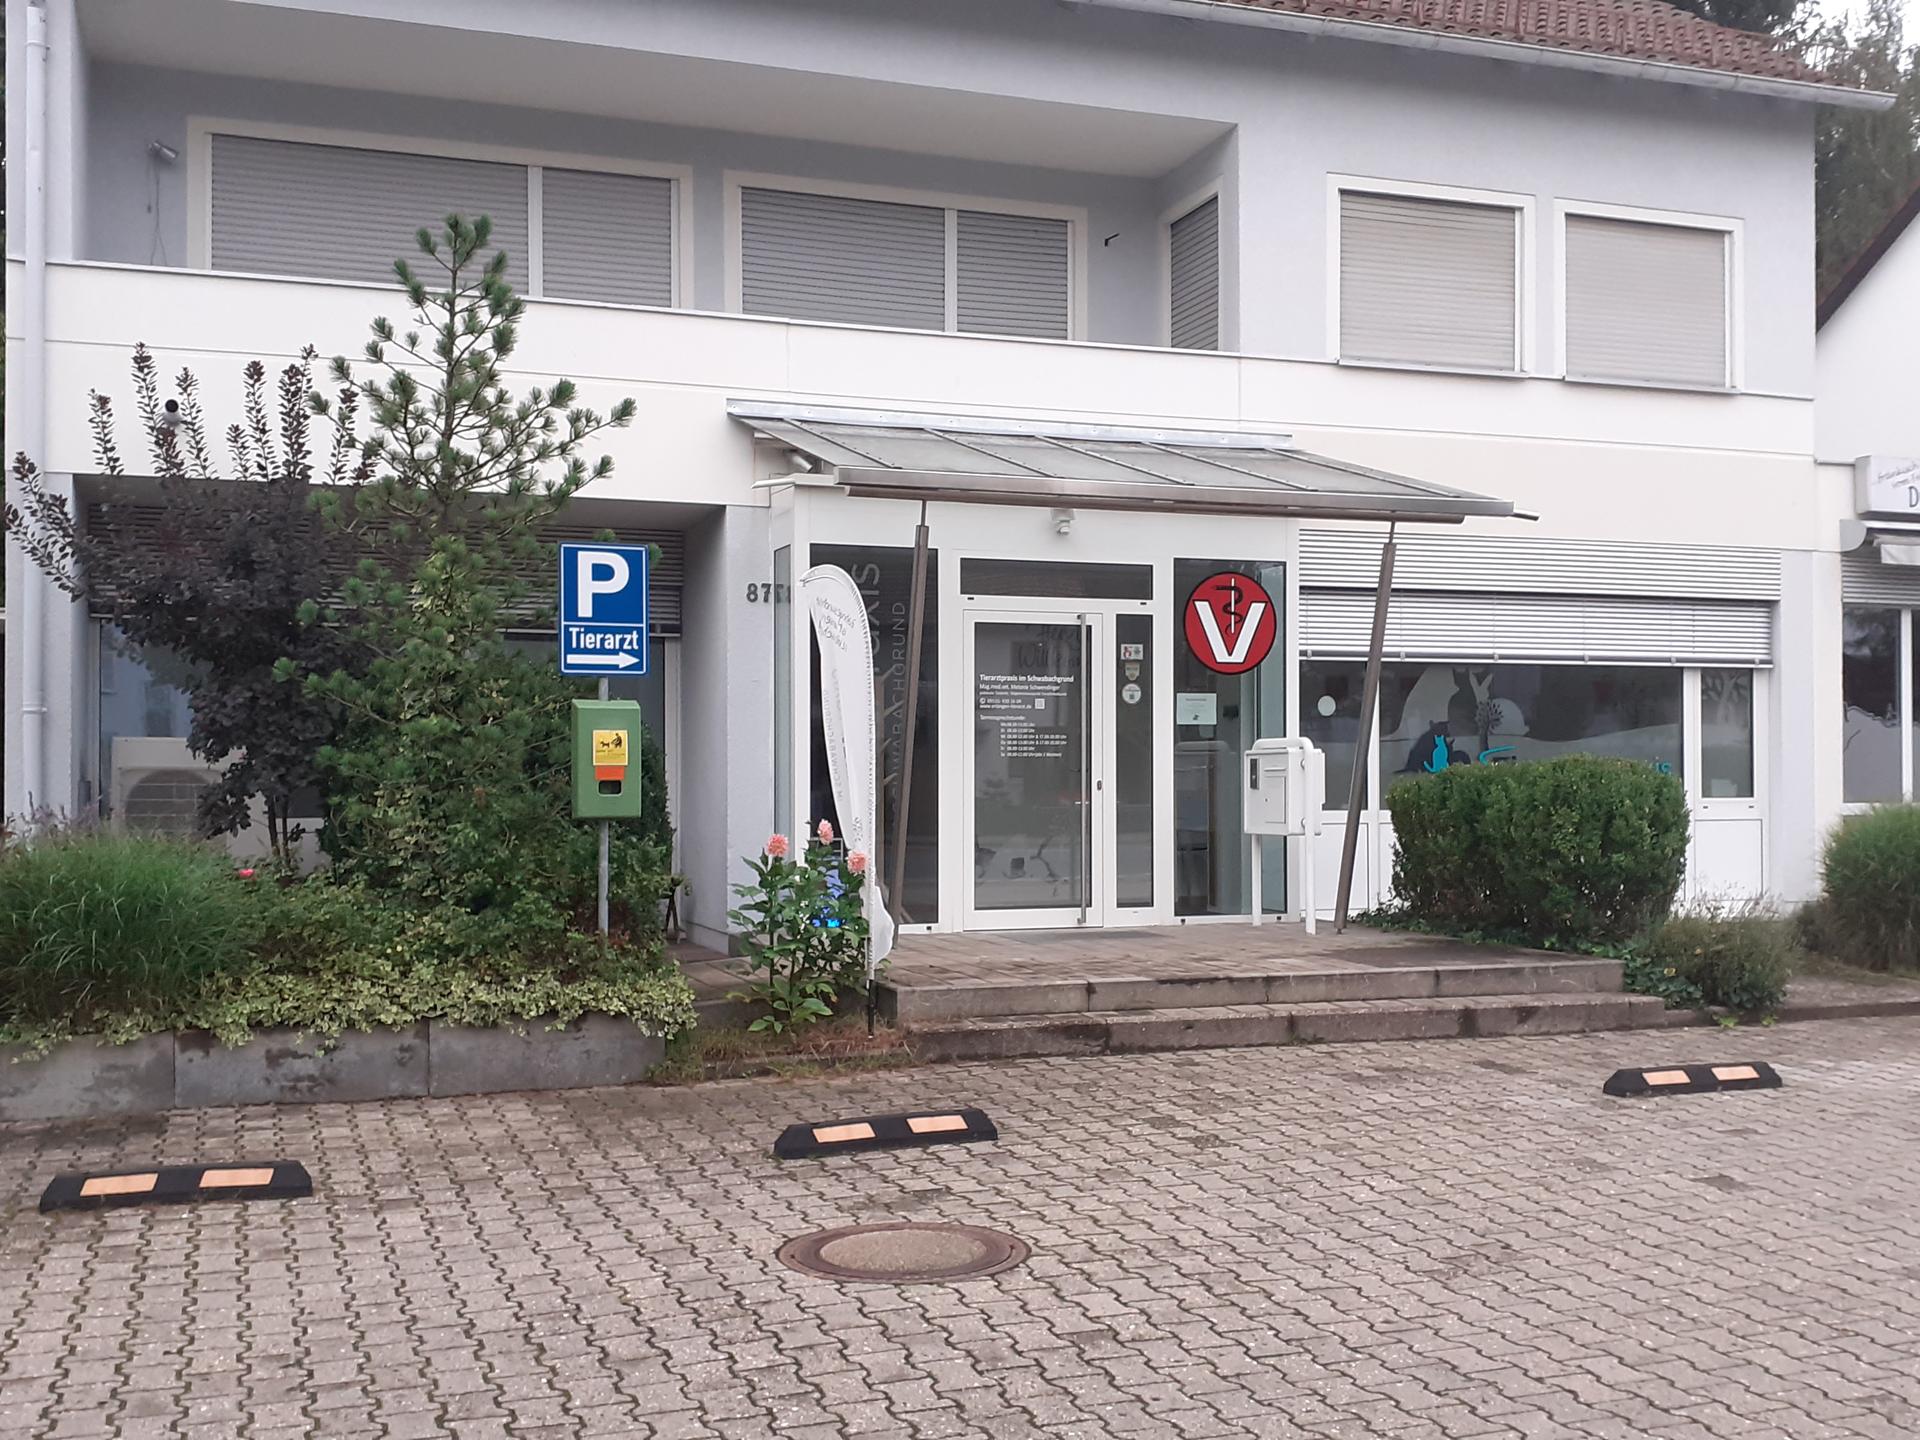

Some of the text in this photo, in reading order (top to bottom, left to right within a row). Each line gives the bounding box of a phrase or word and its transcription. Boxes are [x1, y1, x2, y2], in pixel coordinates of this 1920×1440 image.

[578, 551, 629, 617] P
[746, 583, 772, 603] 87
[569, 627, 638, 649] Tierarzt
[1193, 600, 1267, 663] V
